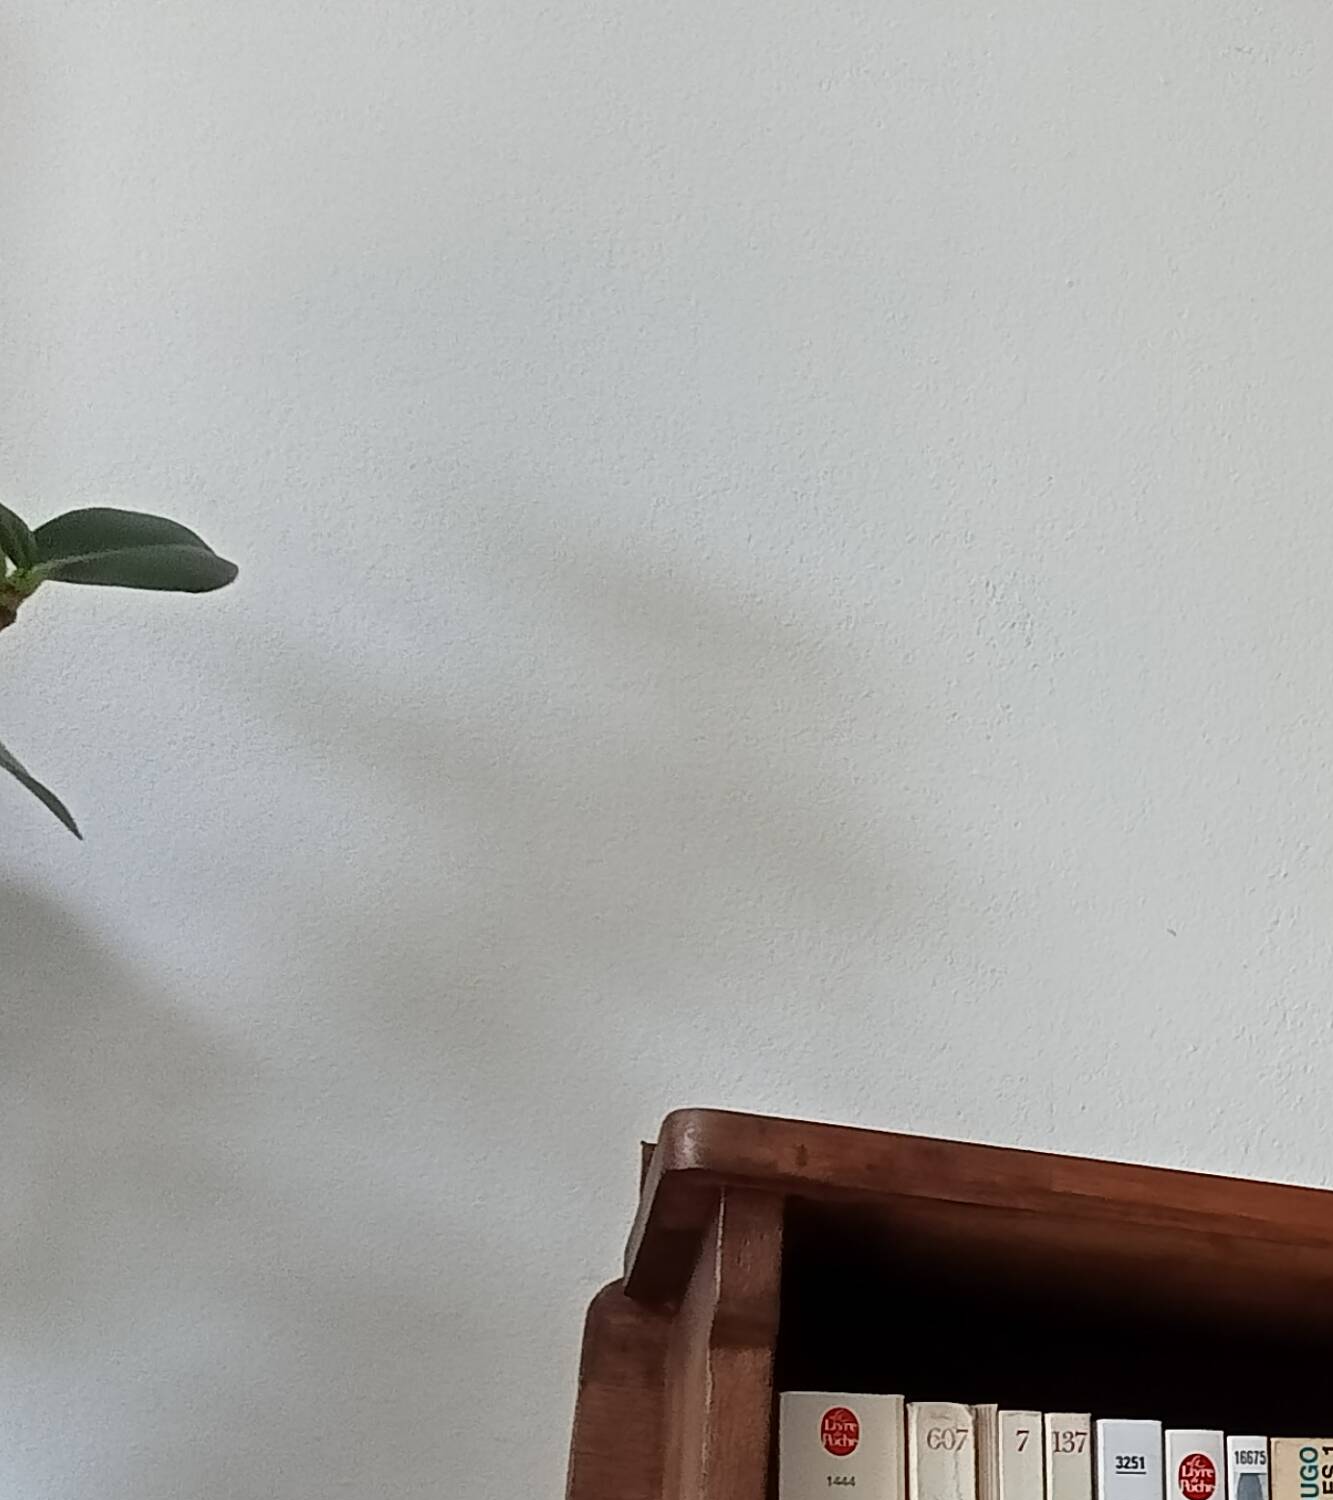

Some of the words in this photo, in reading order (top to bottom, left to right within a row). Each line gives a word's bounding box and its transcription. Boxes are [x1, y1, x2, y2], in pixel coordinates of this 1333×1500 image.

[926, 1429, 969, 1451] 607
[1016, 1429, 1030, 1452] 7
[1052, 1430, 1088, 1453] 137
[1115, 1455, 1146, 1471] 3251
[1234, 1450, 1267, 1466] 16675
[826, 1475, 856, 1487] 1444
